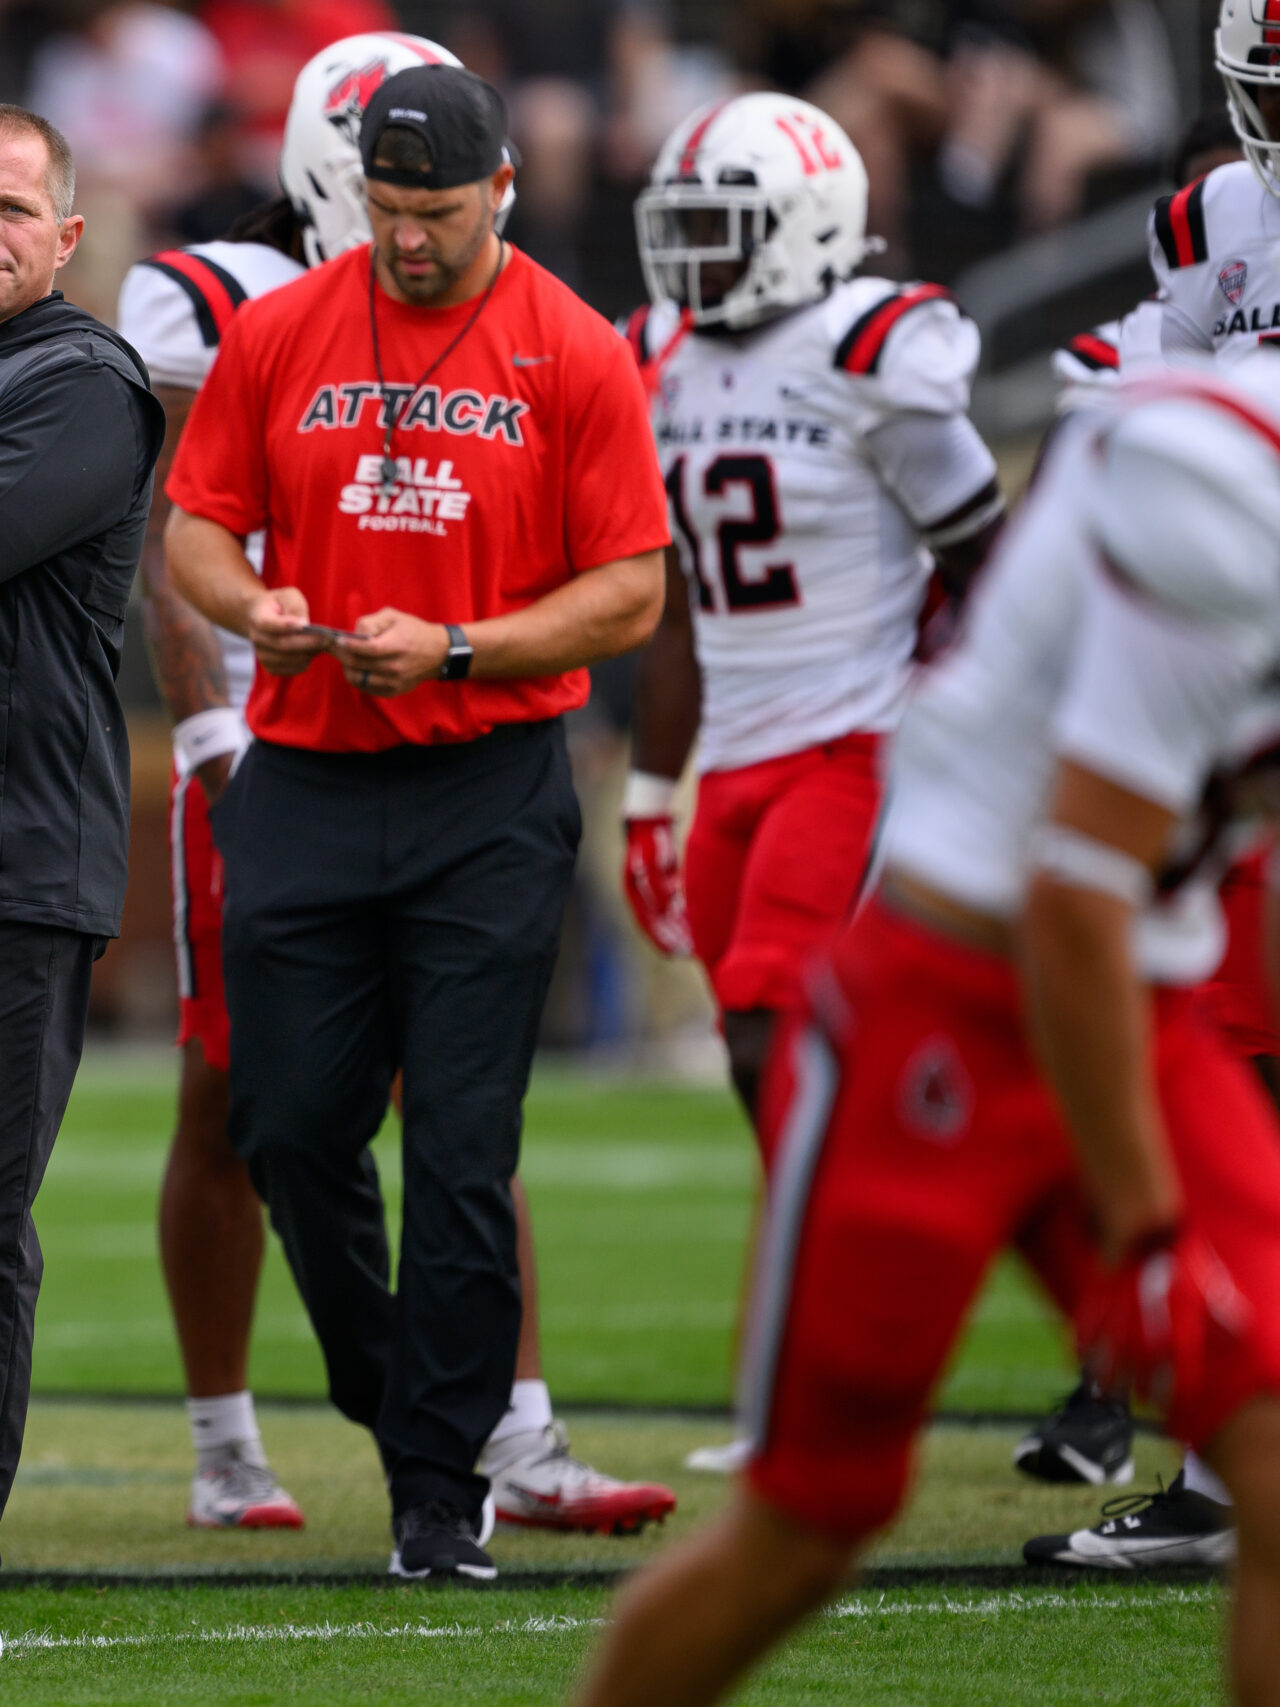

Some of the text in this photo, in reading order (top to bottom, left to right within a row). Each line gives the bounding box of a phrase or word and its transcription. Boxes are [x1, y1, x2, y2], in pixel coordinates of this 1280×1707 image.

[776, 113, 842, 176] 12
[297, 381, 530, 447] ATTACK
[718, 416, 831, 444] STATE
[354, 453, 463, 490] BALL
[338, 483, 471, 521] STATE
[358, 515, 448, 537] FOOTBALL
[666, 452, 803, 616] 12
